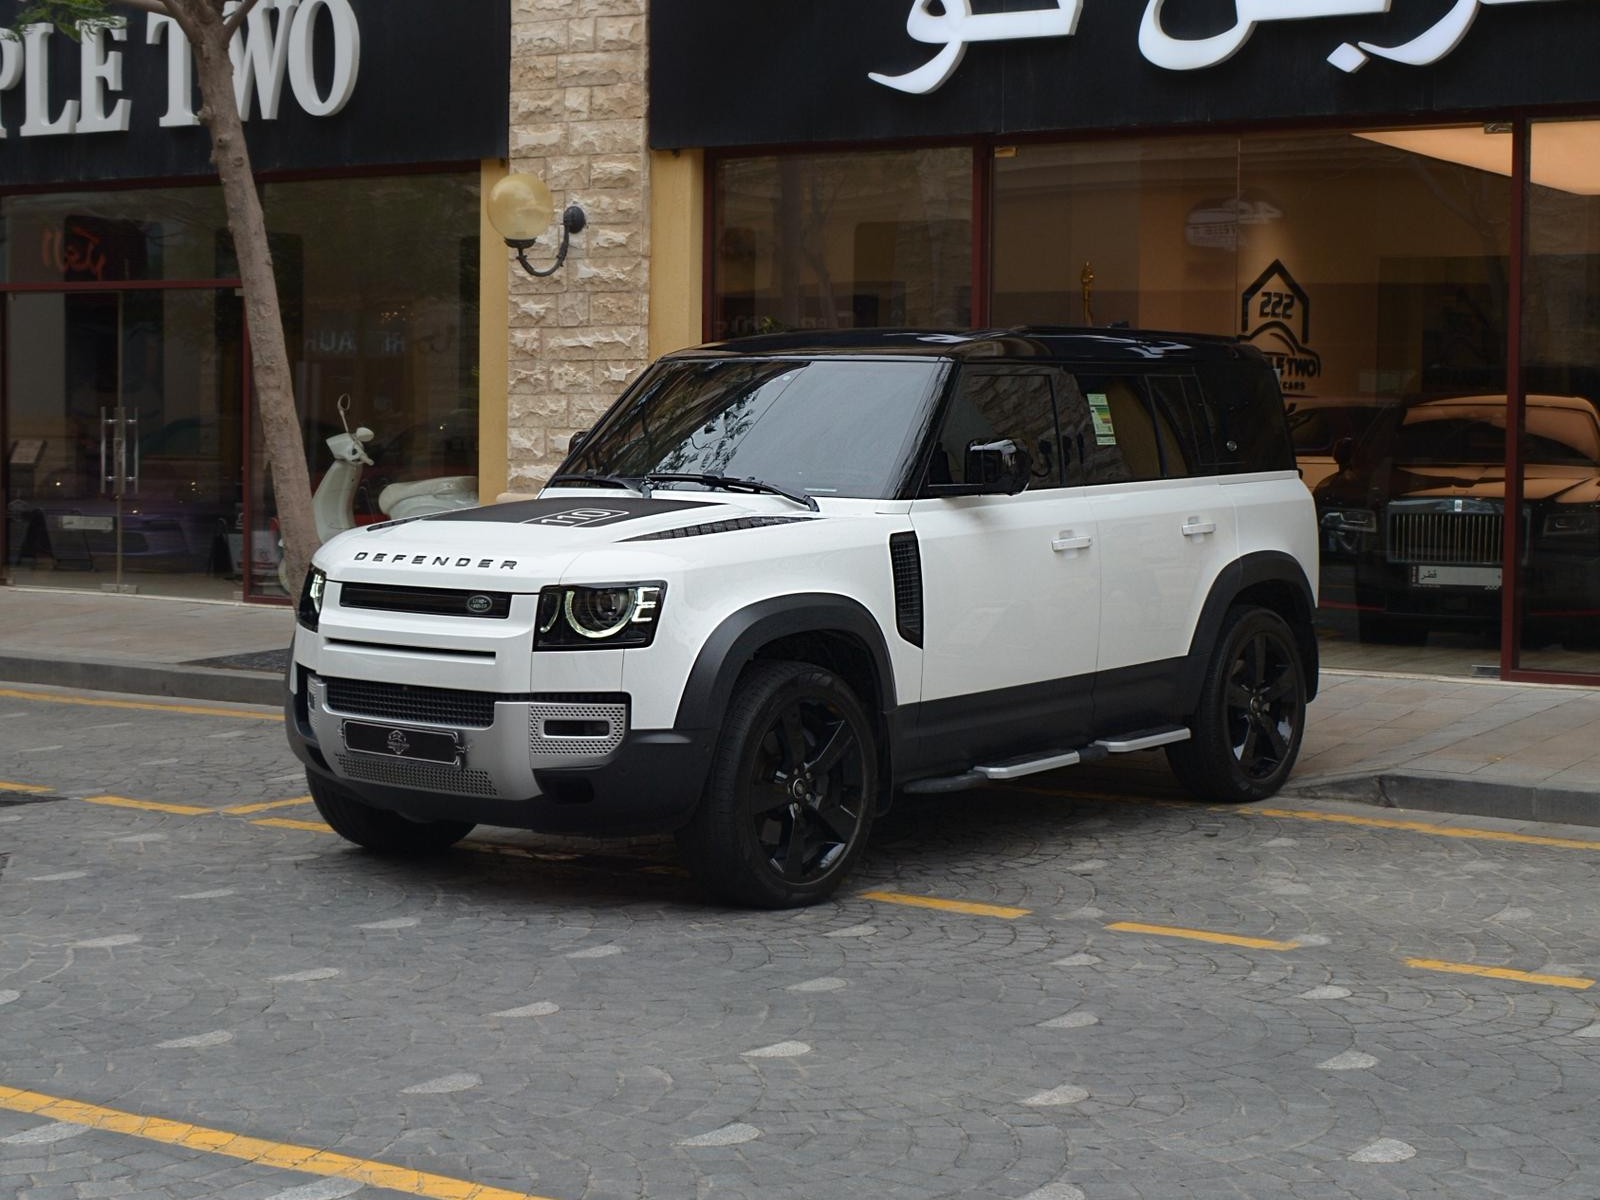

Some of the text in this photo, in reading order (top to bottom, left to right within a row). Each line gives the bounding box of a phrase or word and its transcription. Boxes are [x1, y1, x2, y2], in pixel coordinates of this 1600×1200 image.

[147, 0, 360, 127] TWO
[1259, 291, 1295, 319] 222
[1287, 357, 1316, 377] TWO
[1282, 381, 1306, 391] CARS
[541, 510, 611, 524] 110
[354, 551, 517, 570] DEFENDER
